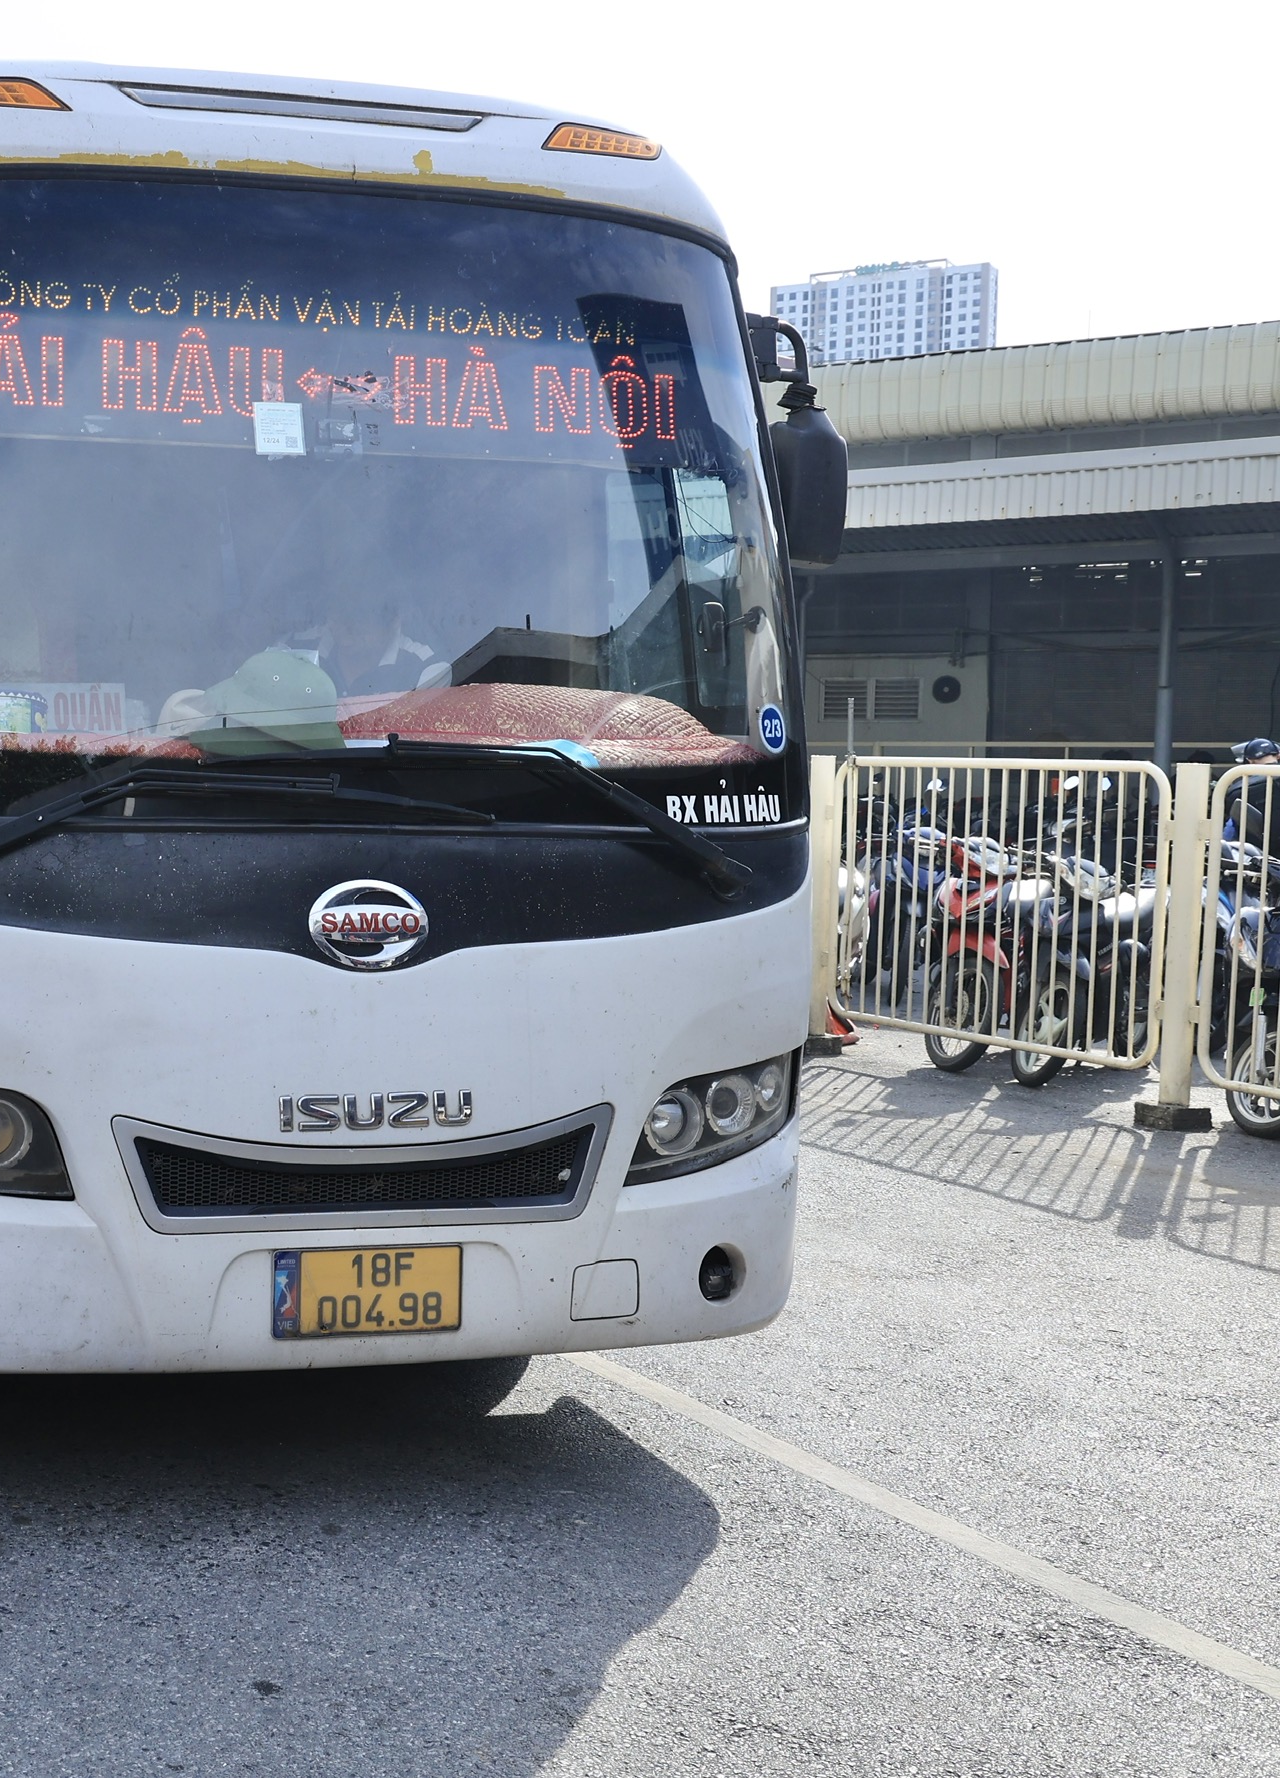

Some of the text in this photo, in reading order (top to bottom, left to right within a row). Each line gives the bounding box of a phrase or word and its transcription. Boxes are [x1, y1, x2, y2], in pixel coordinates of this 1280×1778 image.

[82, 283, 117, 311] TY
[128, 272, 180, 315] CỔ
[193, 279, 280, 321] PHẦN
[293, 289, 360, 332] VẬN
[372, 291, 416, 330] TẢI
[427, 301, 544, 340] HOÀNG
[101, 326, 285, 423] HẬU
[394, 345, 509, 430] HÀ
[533, 355, 676, 449] NỘI
[764, 720, 781, 738] 2/3
[666, 795, 699, 823] BX
[703, 779, 740, 823] HẢI
[321, 911, 420, 935] SAMCO
[278, 1088, 473, 1133] ISUZU
[351, 1251, 415, 1289] 18F
[277, 1320, 293, 1330] VIE
[317, 1291, 442, 1332] 004.98
